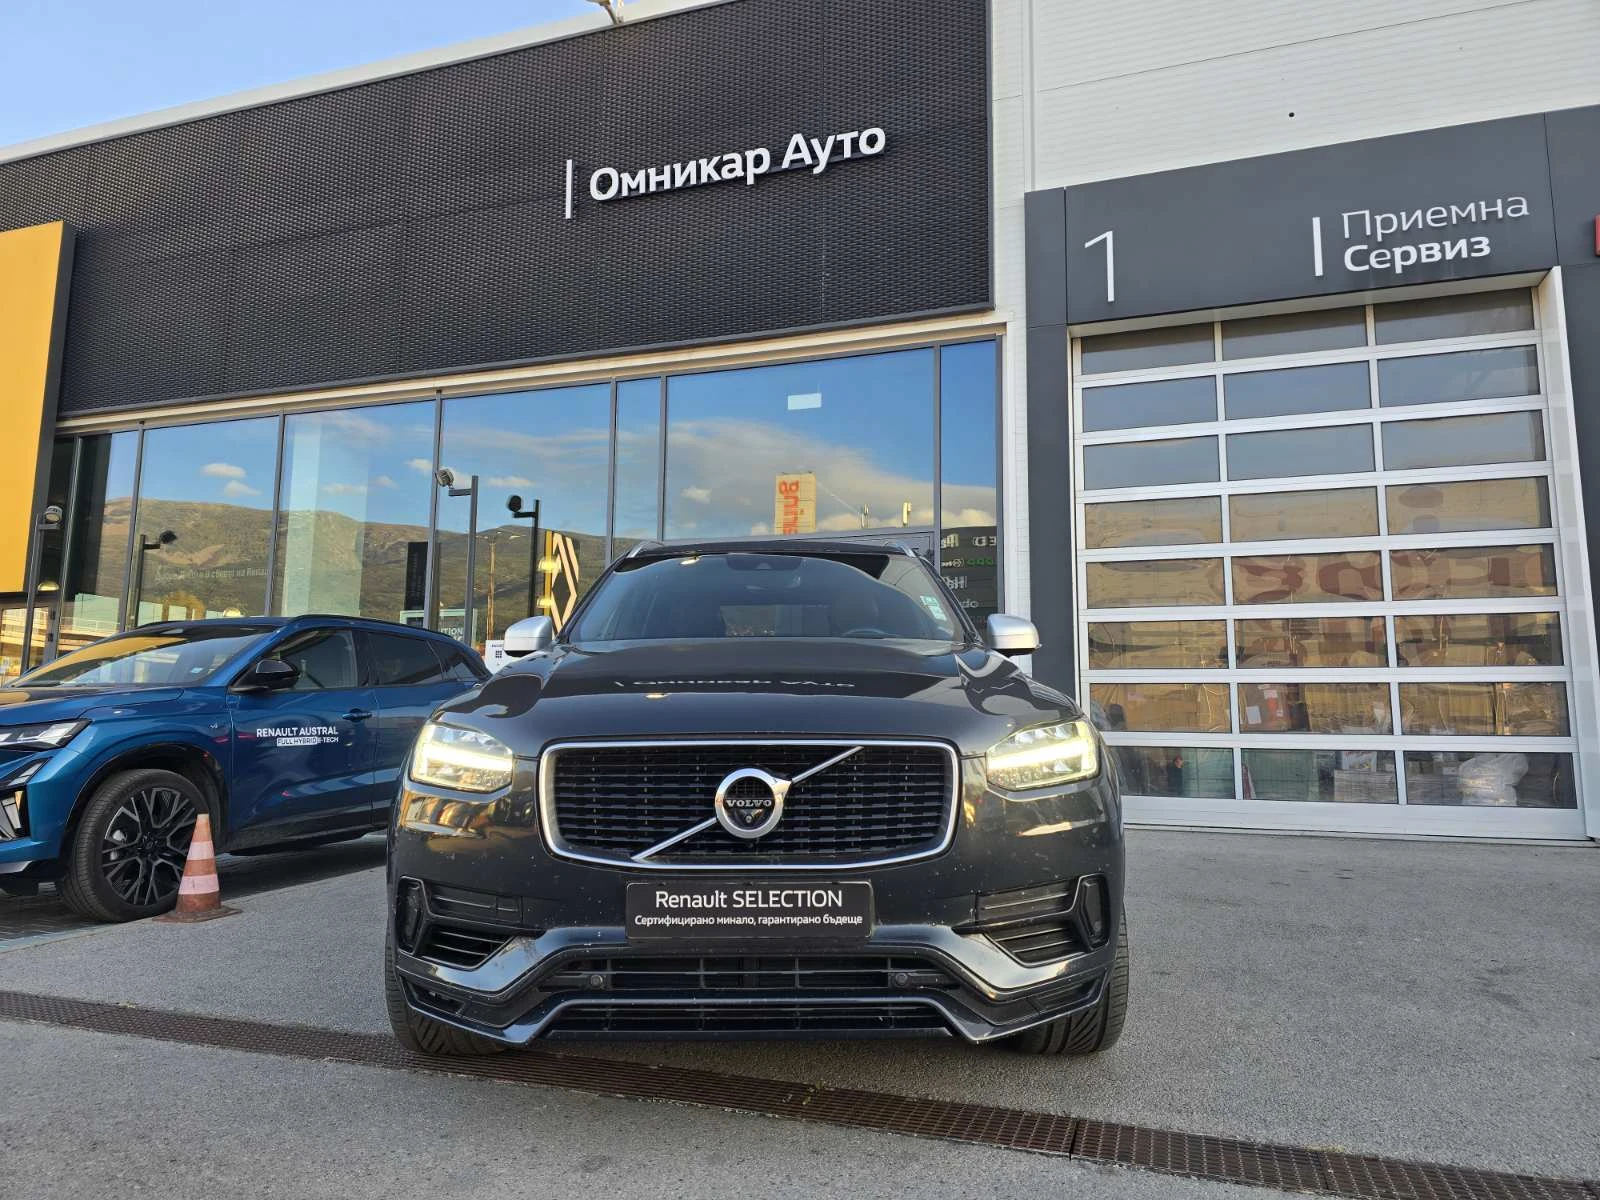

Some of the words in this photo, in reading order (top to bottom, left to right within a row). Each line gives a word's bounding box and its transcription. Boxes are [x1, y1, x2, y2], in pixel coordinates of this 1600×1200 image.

[589, 147, 771, 201] Омникар
[781, 127, 886, 174] Ауто
[1341, 196, 1530, 242] Приемна
[1344, 236, 1491, 274] Сервиз
[1084, 230, 1115, 302] 1
[256, 727, 298, 738] RENAULT
[298, 726, 339, 736] AUSTRAL
[293, 737, 317, 745] HYBRID
[726, 799, 773, 808] VOLVO
[655, 889, 728, 908] Renault
[732, 889, 843, 908] SELECTION
[634, 914, 715, 927] Сертифицирано
[716, 916, 757, 926] минало,
[758, 916, 822, 927] гарантирано
[822, 913, 863, 926] бъдеще
